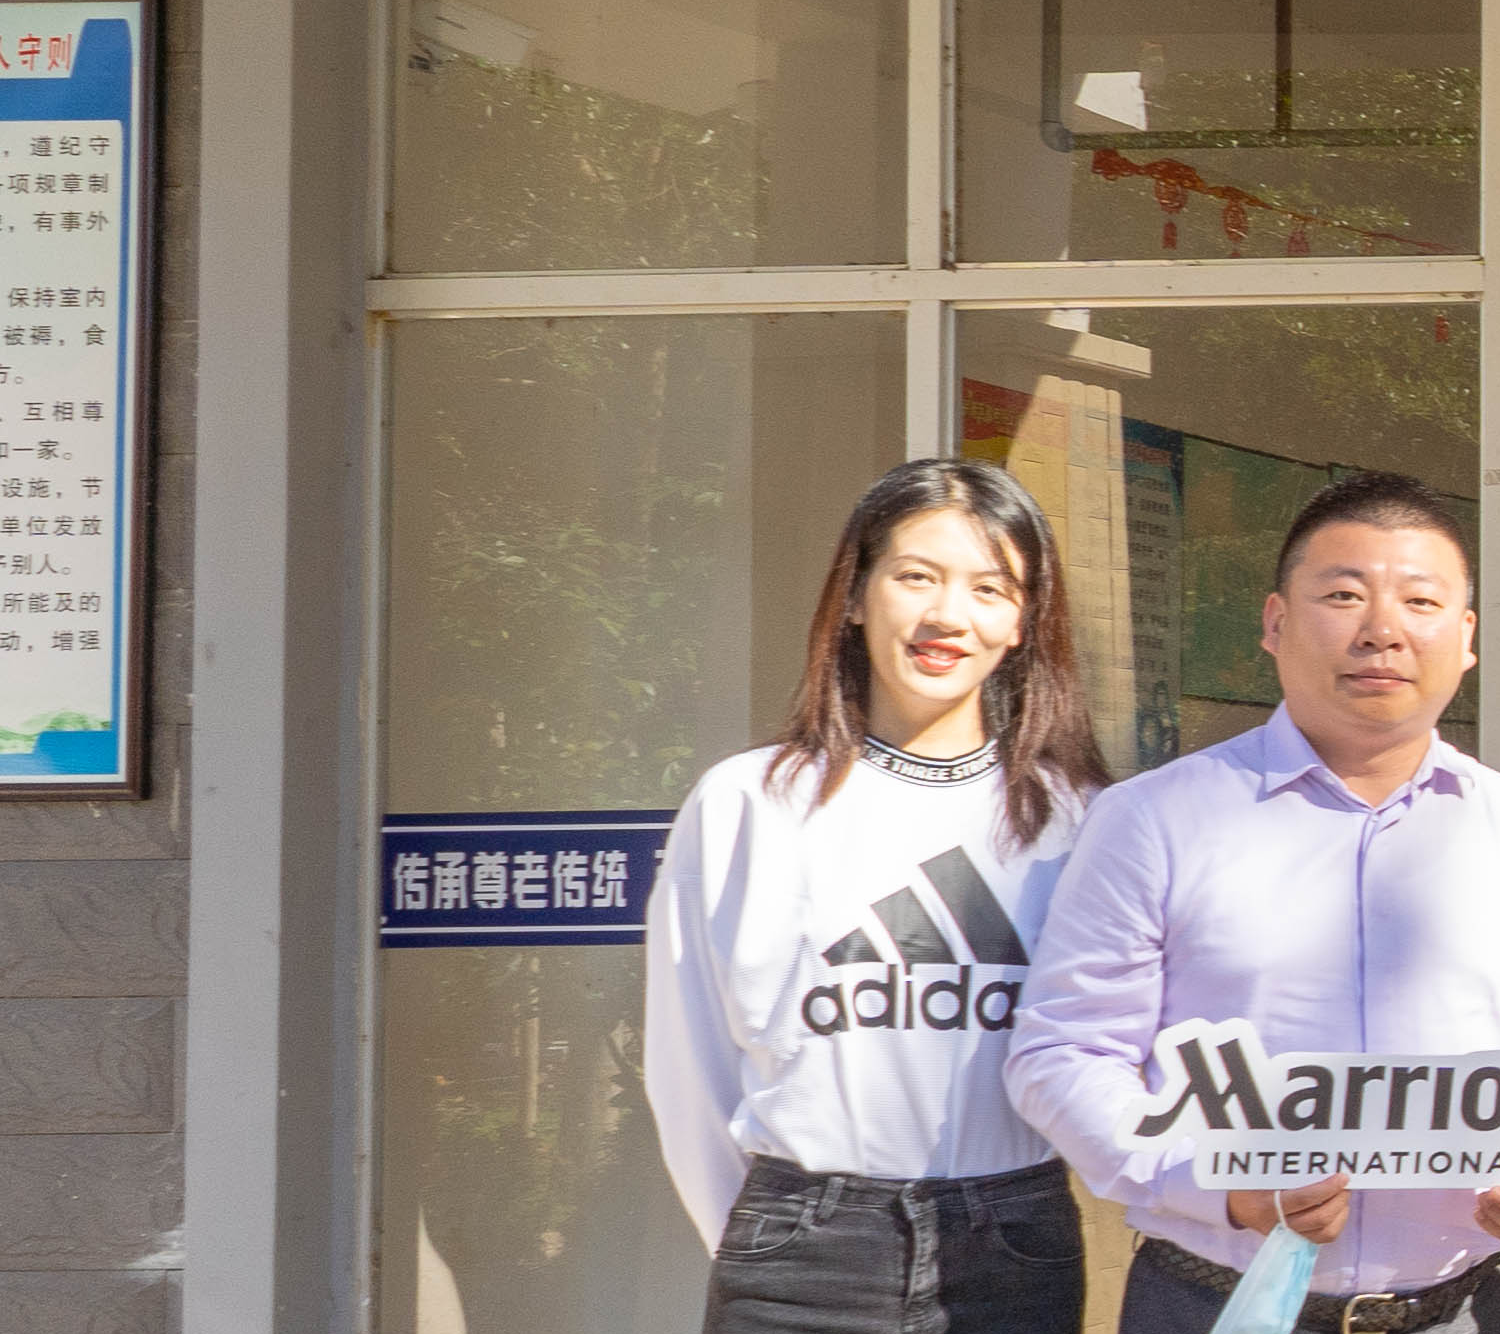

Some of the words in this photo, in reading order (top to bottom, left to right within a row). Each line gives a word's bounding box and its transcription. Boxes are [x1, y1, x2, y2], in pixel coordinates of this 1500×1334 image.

[0, 173, 109, 194] 项规章制
[8, 287, 106, 308] 保持室内
[0, 554, 71, 575] 别人。
[2, 593, 100, 613] 所能及的
[393, 850, 628, 910] 传承尊老传统
[801, 964, 1022, 1036] adida
